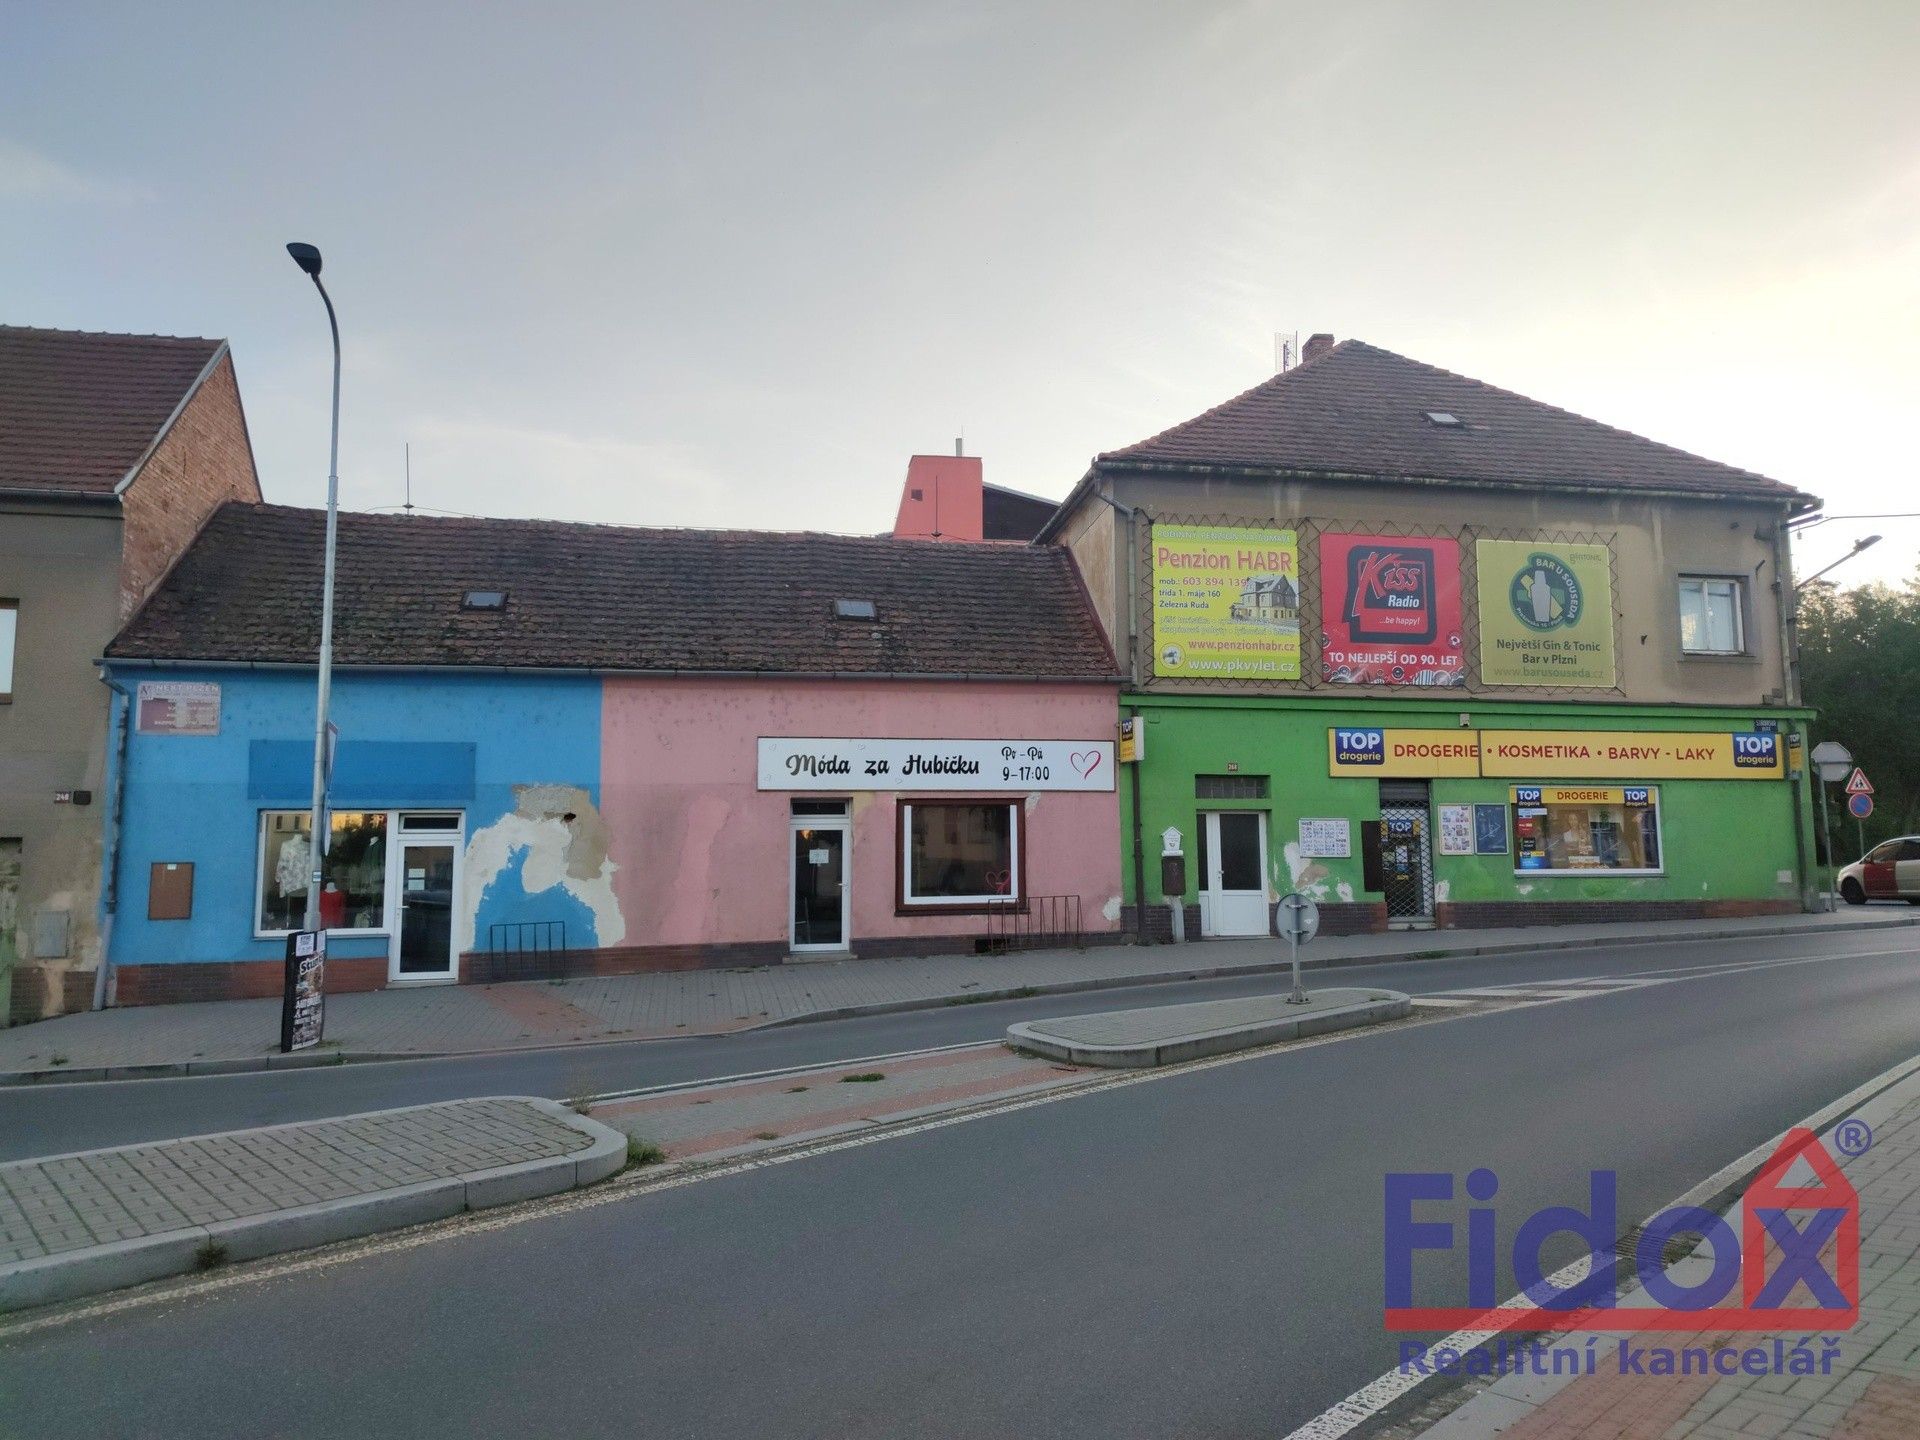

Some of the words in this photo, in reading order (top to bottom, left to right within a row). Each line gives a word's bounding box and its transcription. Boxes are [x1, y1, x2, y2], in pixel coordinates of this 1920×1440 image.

[1158, 547, 1230, 570] Penzion
[1237, 550, 1292, 572] HABR
[1182, 577, 1200, 585] 603
[1205, 578, 1224, 586] 894
[1536, 558, 1555, 570] BAR
[1555, 566, 1563, 574] U
[1562, 573, 1579, 620] SOUSEDA
[1190, 601, 1209, 609] Ruda
[1388, 594, 1420, 608] Radio
[1395, 617, 1420, 625] happy!
[1188, 640, 1295, 651] www.penzionhabr.cz
[1496, 639, 1540, 650] Největší
[1543, 640, 1560, 650] Gin
[1563, 641, 1571, 650] &
[1574, 641, 1601, 651] Tonic
[1329, 652, 1344, 662] TO
[1348, 650, 1396, 663] NEJLEPŠÍ
[1400, 654, 1417, 664] OD
[1421, 655, 1438, 665] 90.
[1441, 655, 1458, 665] LET
[1522, 654, 1540, 664] Bar
[1543, 656, 1549, 664] v
[1552, 654, 1577, 664] Plzni
[1188, 659, 1295, 673] www.pkvylet.cz
[1339, 732, 1381, 749] TOP
[1735, 737, 1772, 753] TOP
[1002, 747, 1017, 760] Po
[1028, 747, 1044, 760] Pá
[1340, 752, 1381, 761] drogerie
[1394, 744, 1479, 758] DROGERIE
[1498, 745, 1590, 758] KOSMETIKA
[1608, 747, 1660, 760] BARVY
[1676, 748, 1715, 760] LAKY
[1737, 755, 1774, 764] drogerie
[786, 754, 850, 777] Móda
[865, 761, 890, 776] za
[902, 755, 981, 776] Hubičku
[1518, 790, 1540, 800] TOP
[1557, 791, 1609, 800] DROGERIE
[1625, 791, 1647, 800] TOP
[1390, 821, 1411, 831] TOP
